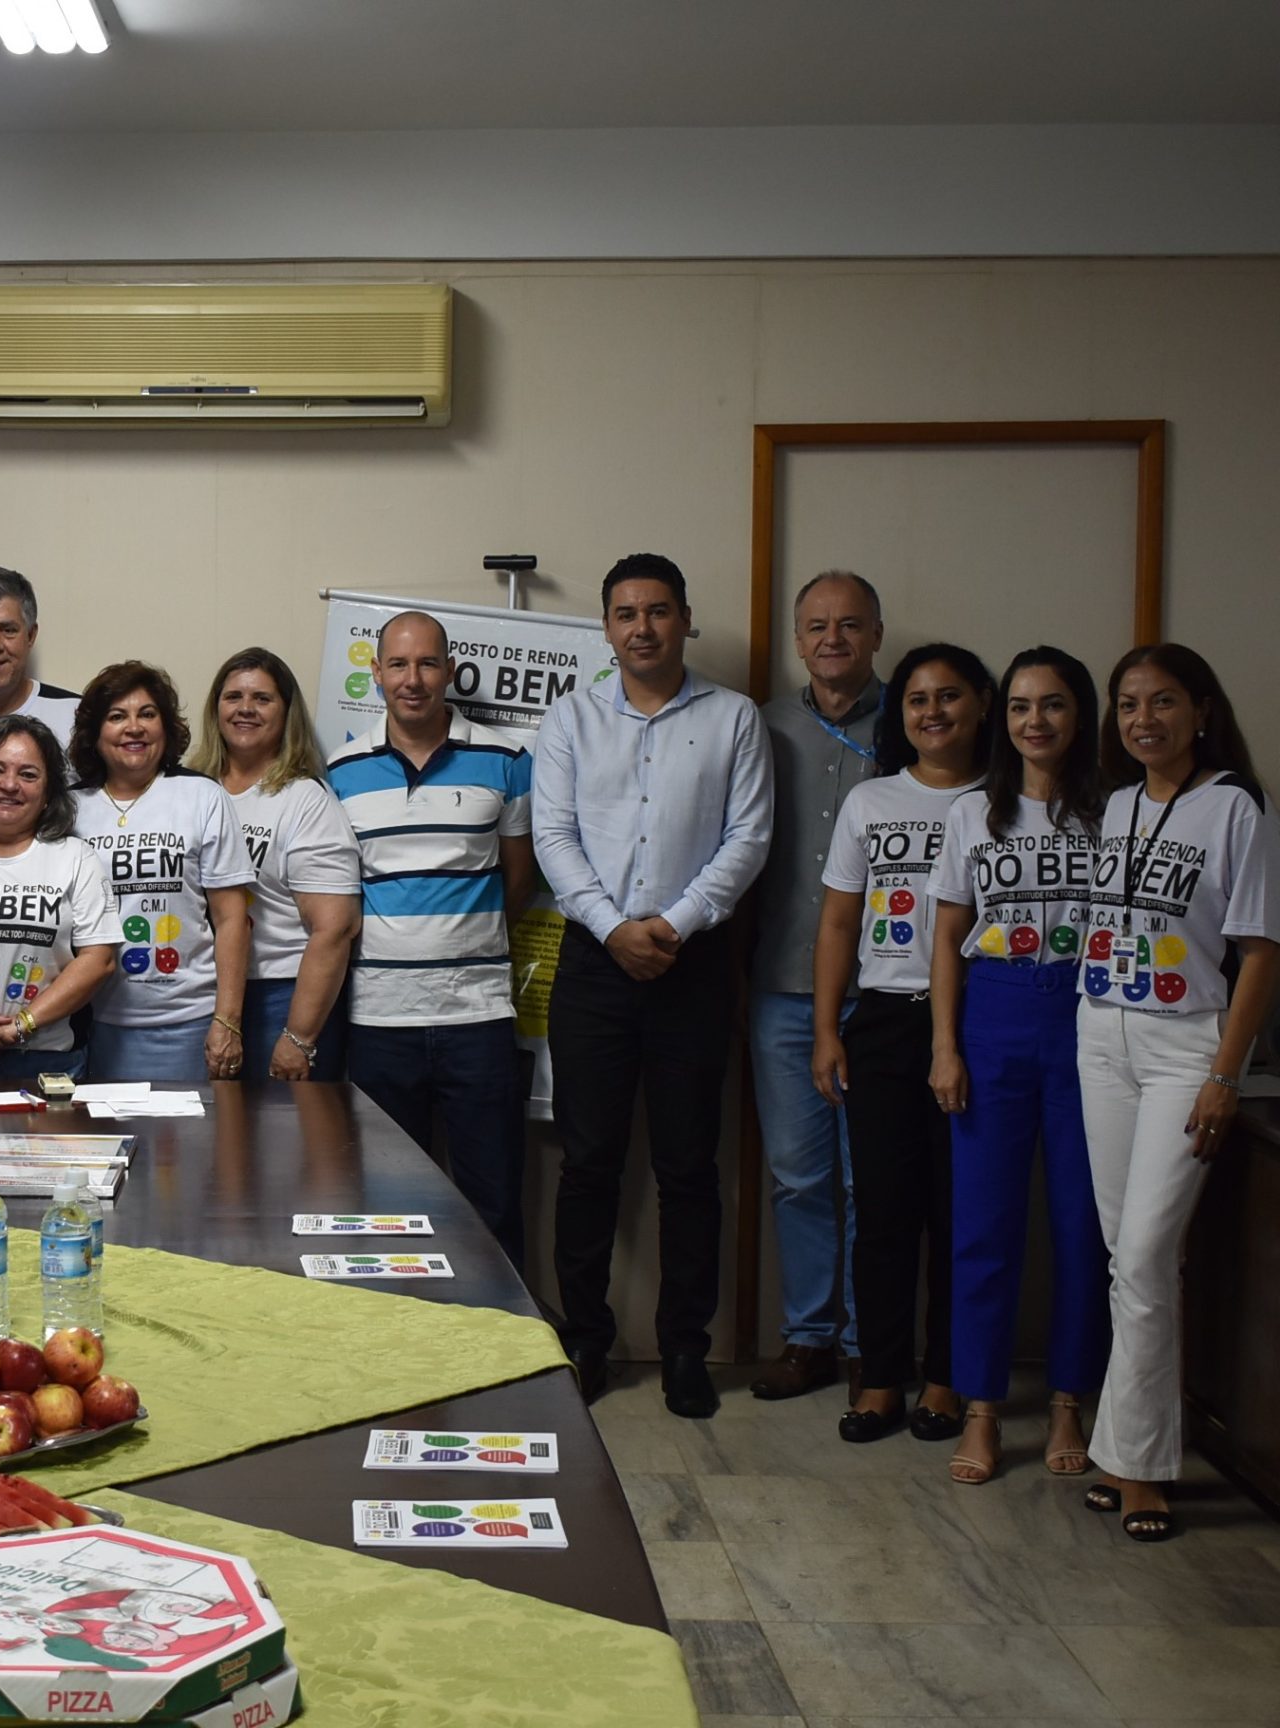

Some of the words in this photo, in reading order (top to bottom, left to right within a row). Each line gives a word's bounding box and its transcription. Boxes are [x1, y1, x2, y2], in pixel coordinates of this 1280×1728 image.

[449, 640, 498, 659] POSTO
[503, 647, 523, 662] DE
[527, 649, 578, 669] RENDA
[453, 661, 480, 697] O
[494, 666, 576, 706] BEM
[498, 710, 511, 722] FAZ
[512, 712, 529, 723] TODA
[117, 834, 135, 848] DE
[139, 832, 185, 851] RENDA
[242, 823, 272, 838] ENDA
[970, 836, 1036, 860] IMPOSTO
[1041, 835, 1061, 851] DE
[1156, 840, 1207, 868] RENDA
[112, 848, 184, 880] BEM
[978, 854, 1022, 892] DO
[3, 884, 19, 893] DE
[22, 885, 63, 895] RENDA
[121, 886, 131, 895] FAZ
[133, 884, 147, 893] TODA
[148, 882, 181, 892] DIFERENÇA
[1131, 857, 1202, 903] BEM
[1016, 891, 1044, 901] ATITUDE
[1045, 890, 1059, 900] FAZ
[0, 929, 10, 938] FAZ
[11, 929, 26, 939] TODA
[47, 1691, 115, 1714] PIZZA
[233, 1700, 276, 1728] PIZZA
